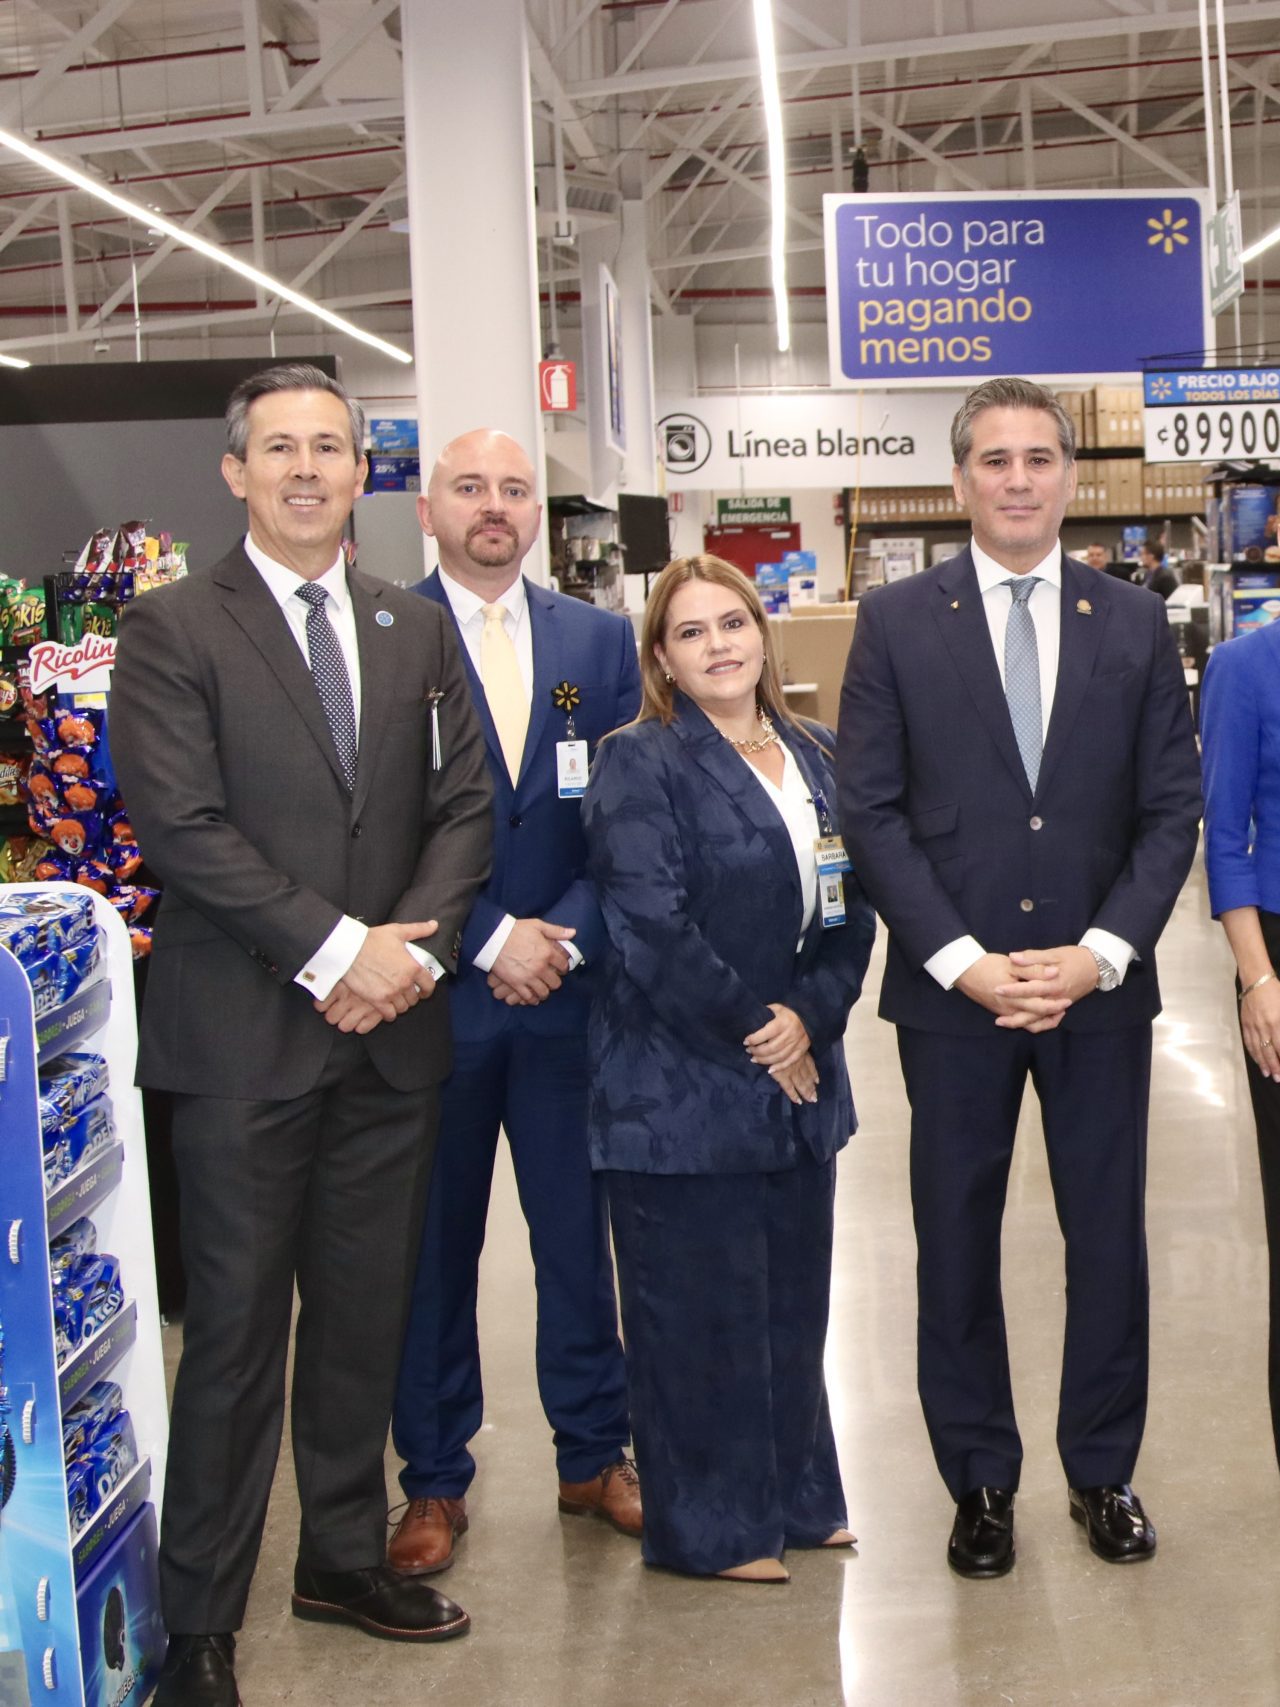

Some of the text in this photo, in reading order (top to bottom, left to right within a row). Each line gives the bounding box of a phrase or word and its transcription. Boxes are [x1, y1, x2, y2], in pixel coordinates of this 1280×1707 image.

[854, 213, 1045, 254] Todo para
[856, 252, 1017, 293] tu hogar
[858, 288, 1033, 333] pagando
[860, 335, 993, 365] menos
[1177, 372, 1280, 390] PRECIO BAJO
[1185, 386, 1280, 402] TODOS LOS DÍAS
[728, 429, 916, 458] Línea blanca
[728, 497, 782, 510] SALIDA DE
[720, 512, 789, 524] EMERGENCIA
[33, 635, 116, 683] Ricolin
[66, 1008, 85, 1029] JUEGA
[78, 1172, 97, 1198] JUEGA
[93, 1338, 111, 1365] JUEGA
[107, 1499, 126, 1530] JUEGA
